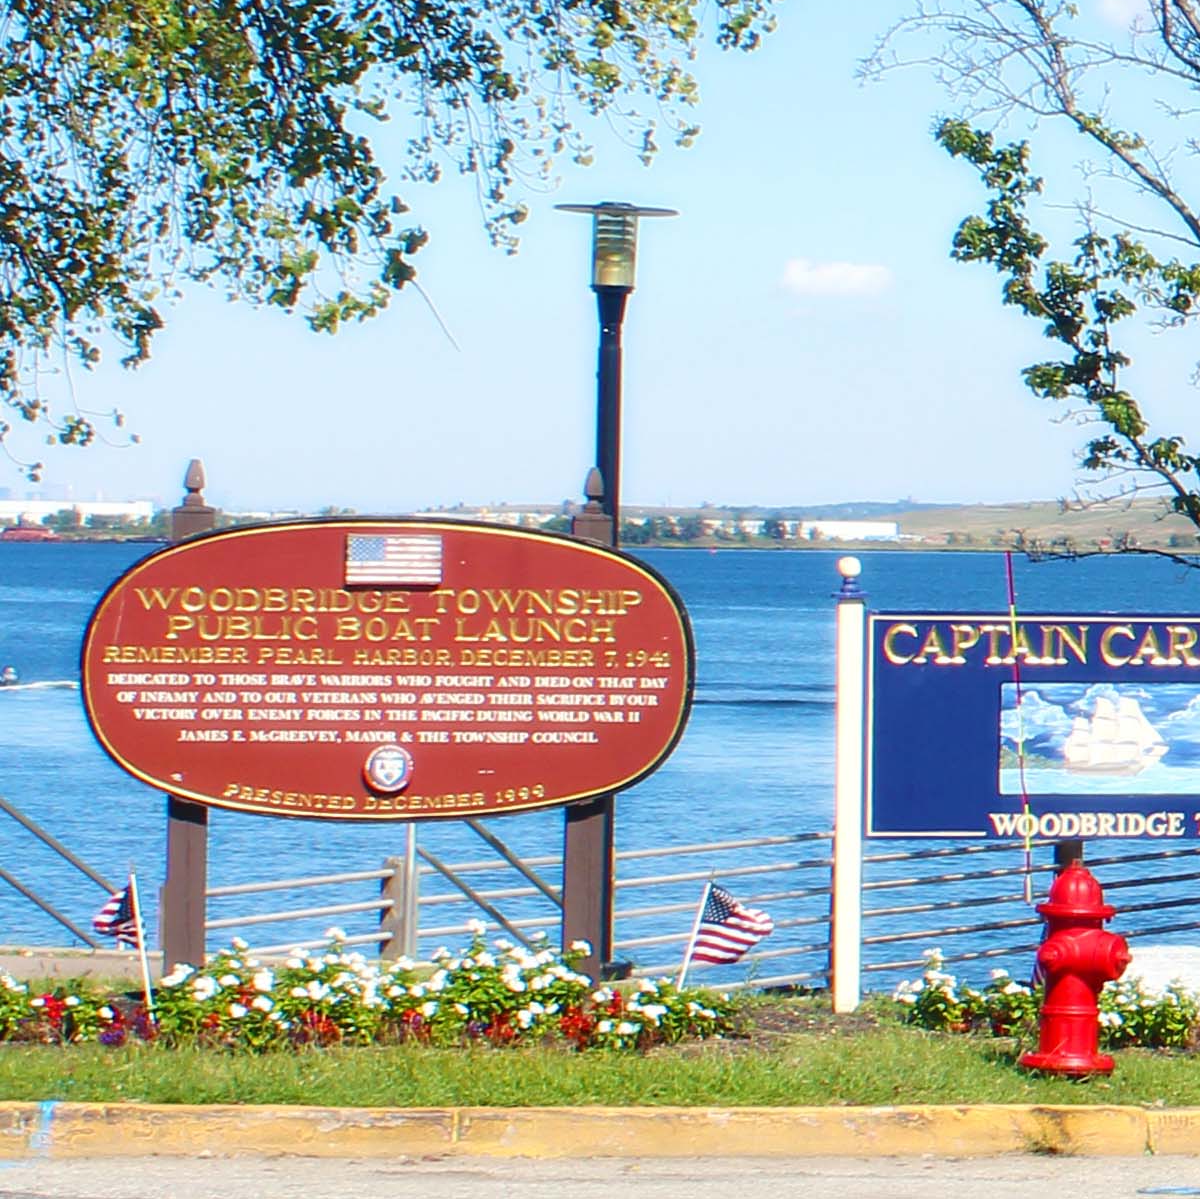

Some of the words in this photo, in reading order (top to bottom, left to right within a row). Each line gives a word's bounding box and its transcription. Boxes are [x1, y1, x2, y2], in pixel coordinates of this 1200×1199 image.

[134, 587, 410, 614] WOODBRIDGE
[430, 589, 643, 615] TOWNSHIP
[165, 616, 319, 641] PUBLIC
[333, 616, 440, 641] BOAT
[453, 618, 617, 642] LAUNCH
[883, 622, 1089, 668] CAPTAIN
[103, 646, 250, 663] REMEMBER
[256, 647, 343, 665] PEARL
[352, 647, 455, 668] HARBOR,
[460, 649, 595, 667] DECEMBER
[604, 650, 620, 669] 7,
[625, 649, 671, 668] 1941
[107, 674, 190, 686] DEDICATED
[193, 674, 216, 686] TO
[219, 674, 267, 686] THOSE
[271, 674, 316, 686] BRAVE
[321, 675, 392, 687] WARRIORS
[396, 675, 432, 687] WHO
[435, 676, 494, 688] FOUGHT
[497, 676, 531, 688] AND
[597, 676, 636, 688] THAT
[640, 676, 668, 688] DAY
[116, 691, 136, 704] OF
[140, 691, 199, 704] INFAMY
[202, 691, 237, 704] AND
[240, 691, 262, 704] TO
[265, 691, 297, 704] OUR
[301, 691, 377, 704] VETERANS
[380, 691, 416, 704] WHO
[419, 691, 485, 704] AVENGED
[487, 691, 533, 704] THEIR
[536, 693, 606, 706] SACRIFICE
[133, 709, 198, 721] VICTORY
[201, 709, 243, 721] OVER
[248, 709, 303, 721] ENEMY
[306, 709, 361, 721] FORCES
[364, 709, 382, 721] IN
[386, 709, 418, 721] THE
[537, 710, 590, 723] WORLD
[593, 710, 624, 723] WAR
[627, 710, 641, 723] II
[177, 730, 229, 743] JAMES
[345, 730, 396, 743] MAYOR
[399, 730, 413, 743] &
[416, 730, 449, 743] THE
[452, 730, 529, 743] TOWNSHIP
[532, 730, 598, 743] COUNCIL
[223, 783, 357, 810] PRESENTED
[362, 791, 486, 810] DECEMBER
[496, 784, 545, 804] 1999
[989, 812, 1186, 838] WOODBRIDGE
